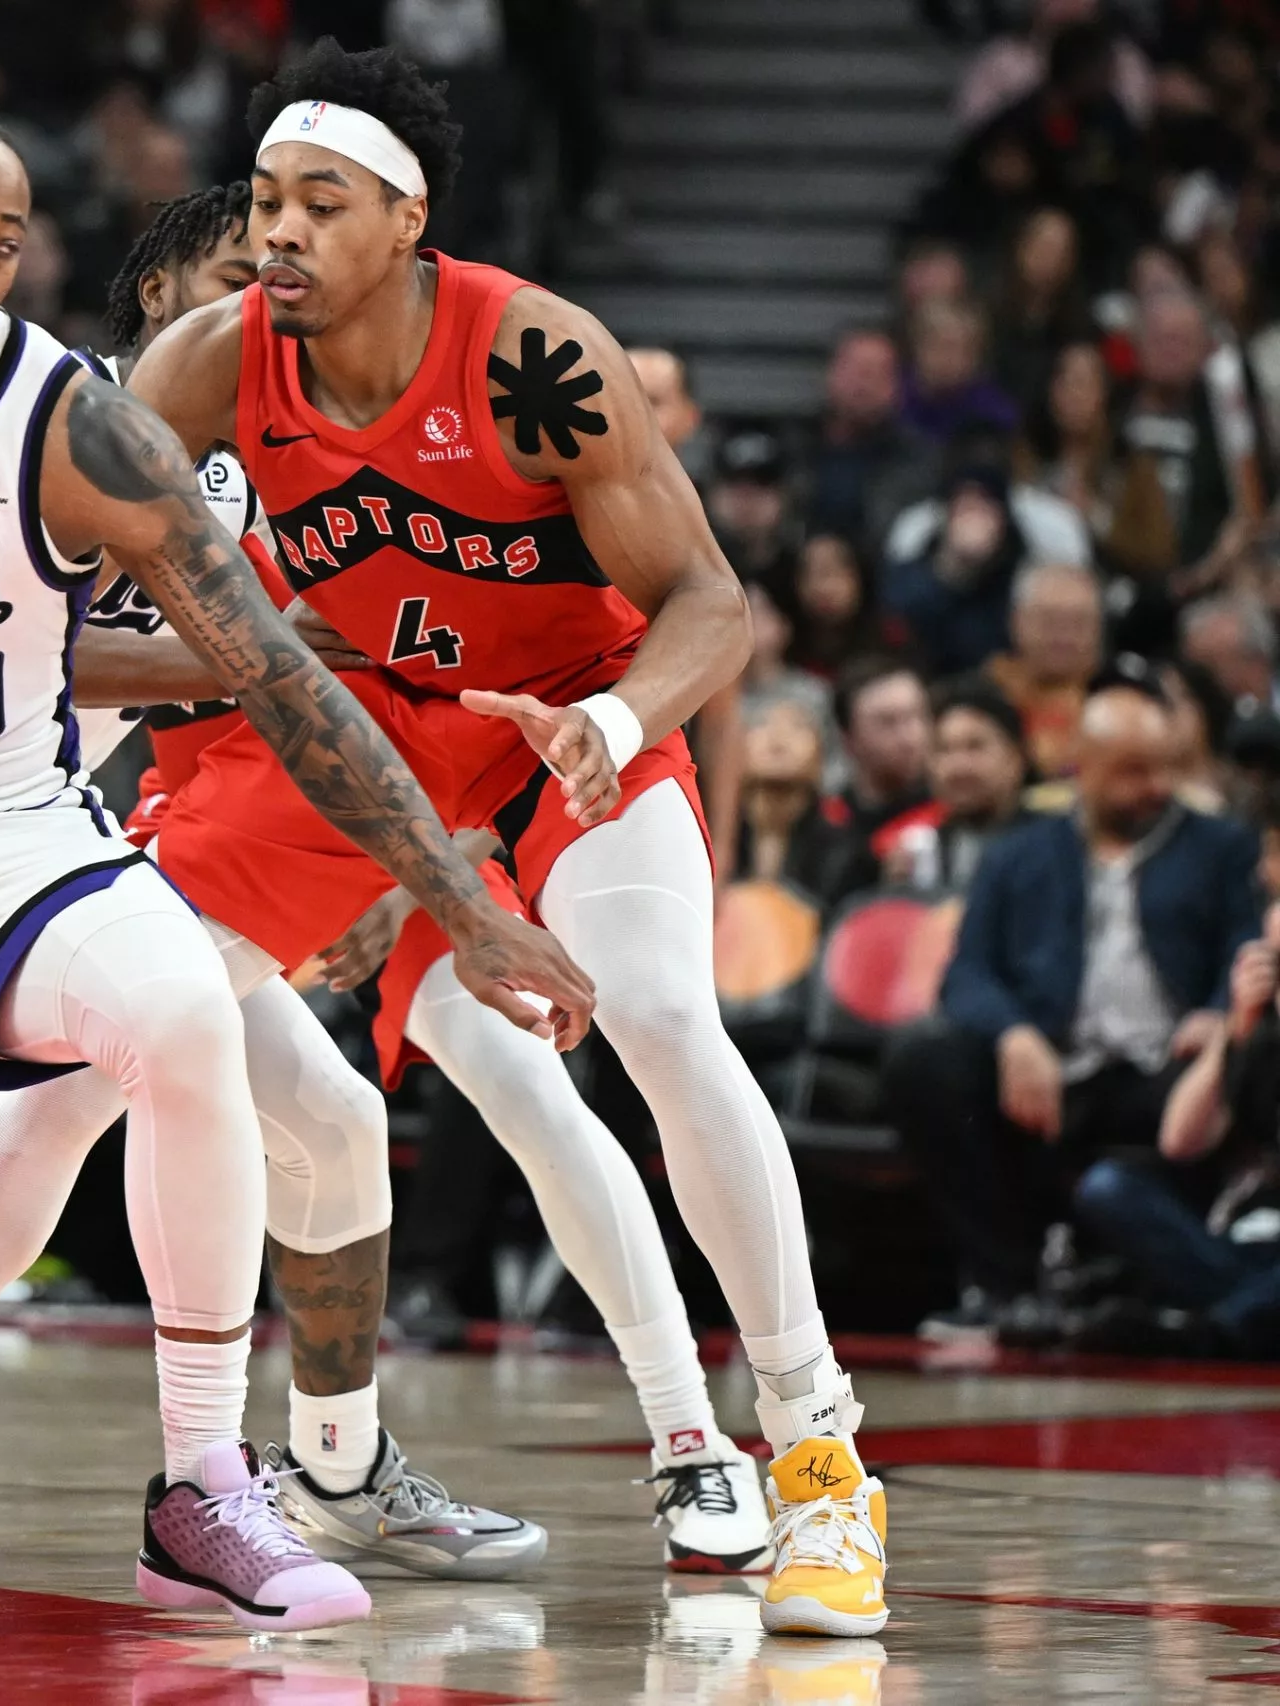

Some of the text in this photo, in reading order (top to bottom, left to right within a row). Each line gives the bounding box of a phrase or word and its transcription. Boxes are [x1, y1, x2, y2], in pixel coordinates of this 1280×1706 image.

[417, 444, 473, 462] Sun Life
[276, 495, 541, 578] RAPTORS
[387, 596, 465, 669] 4
